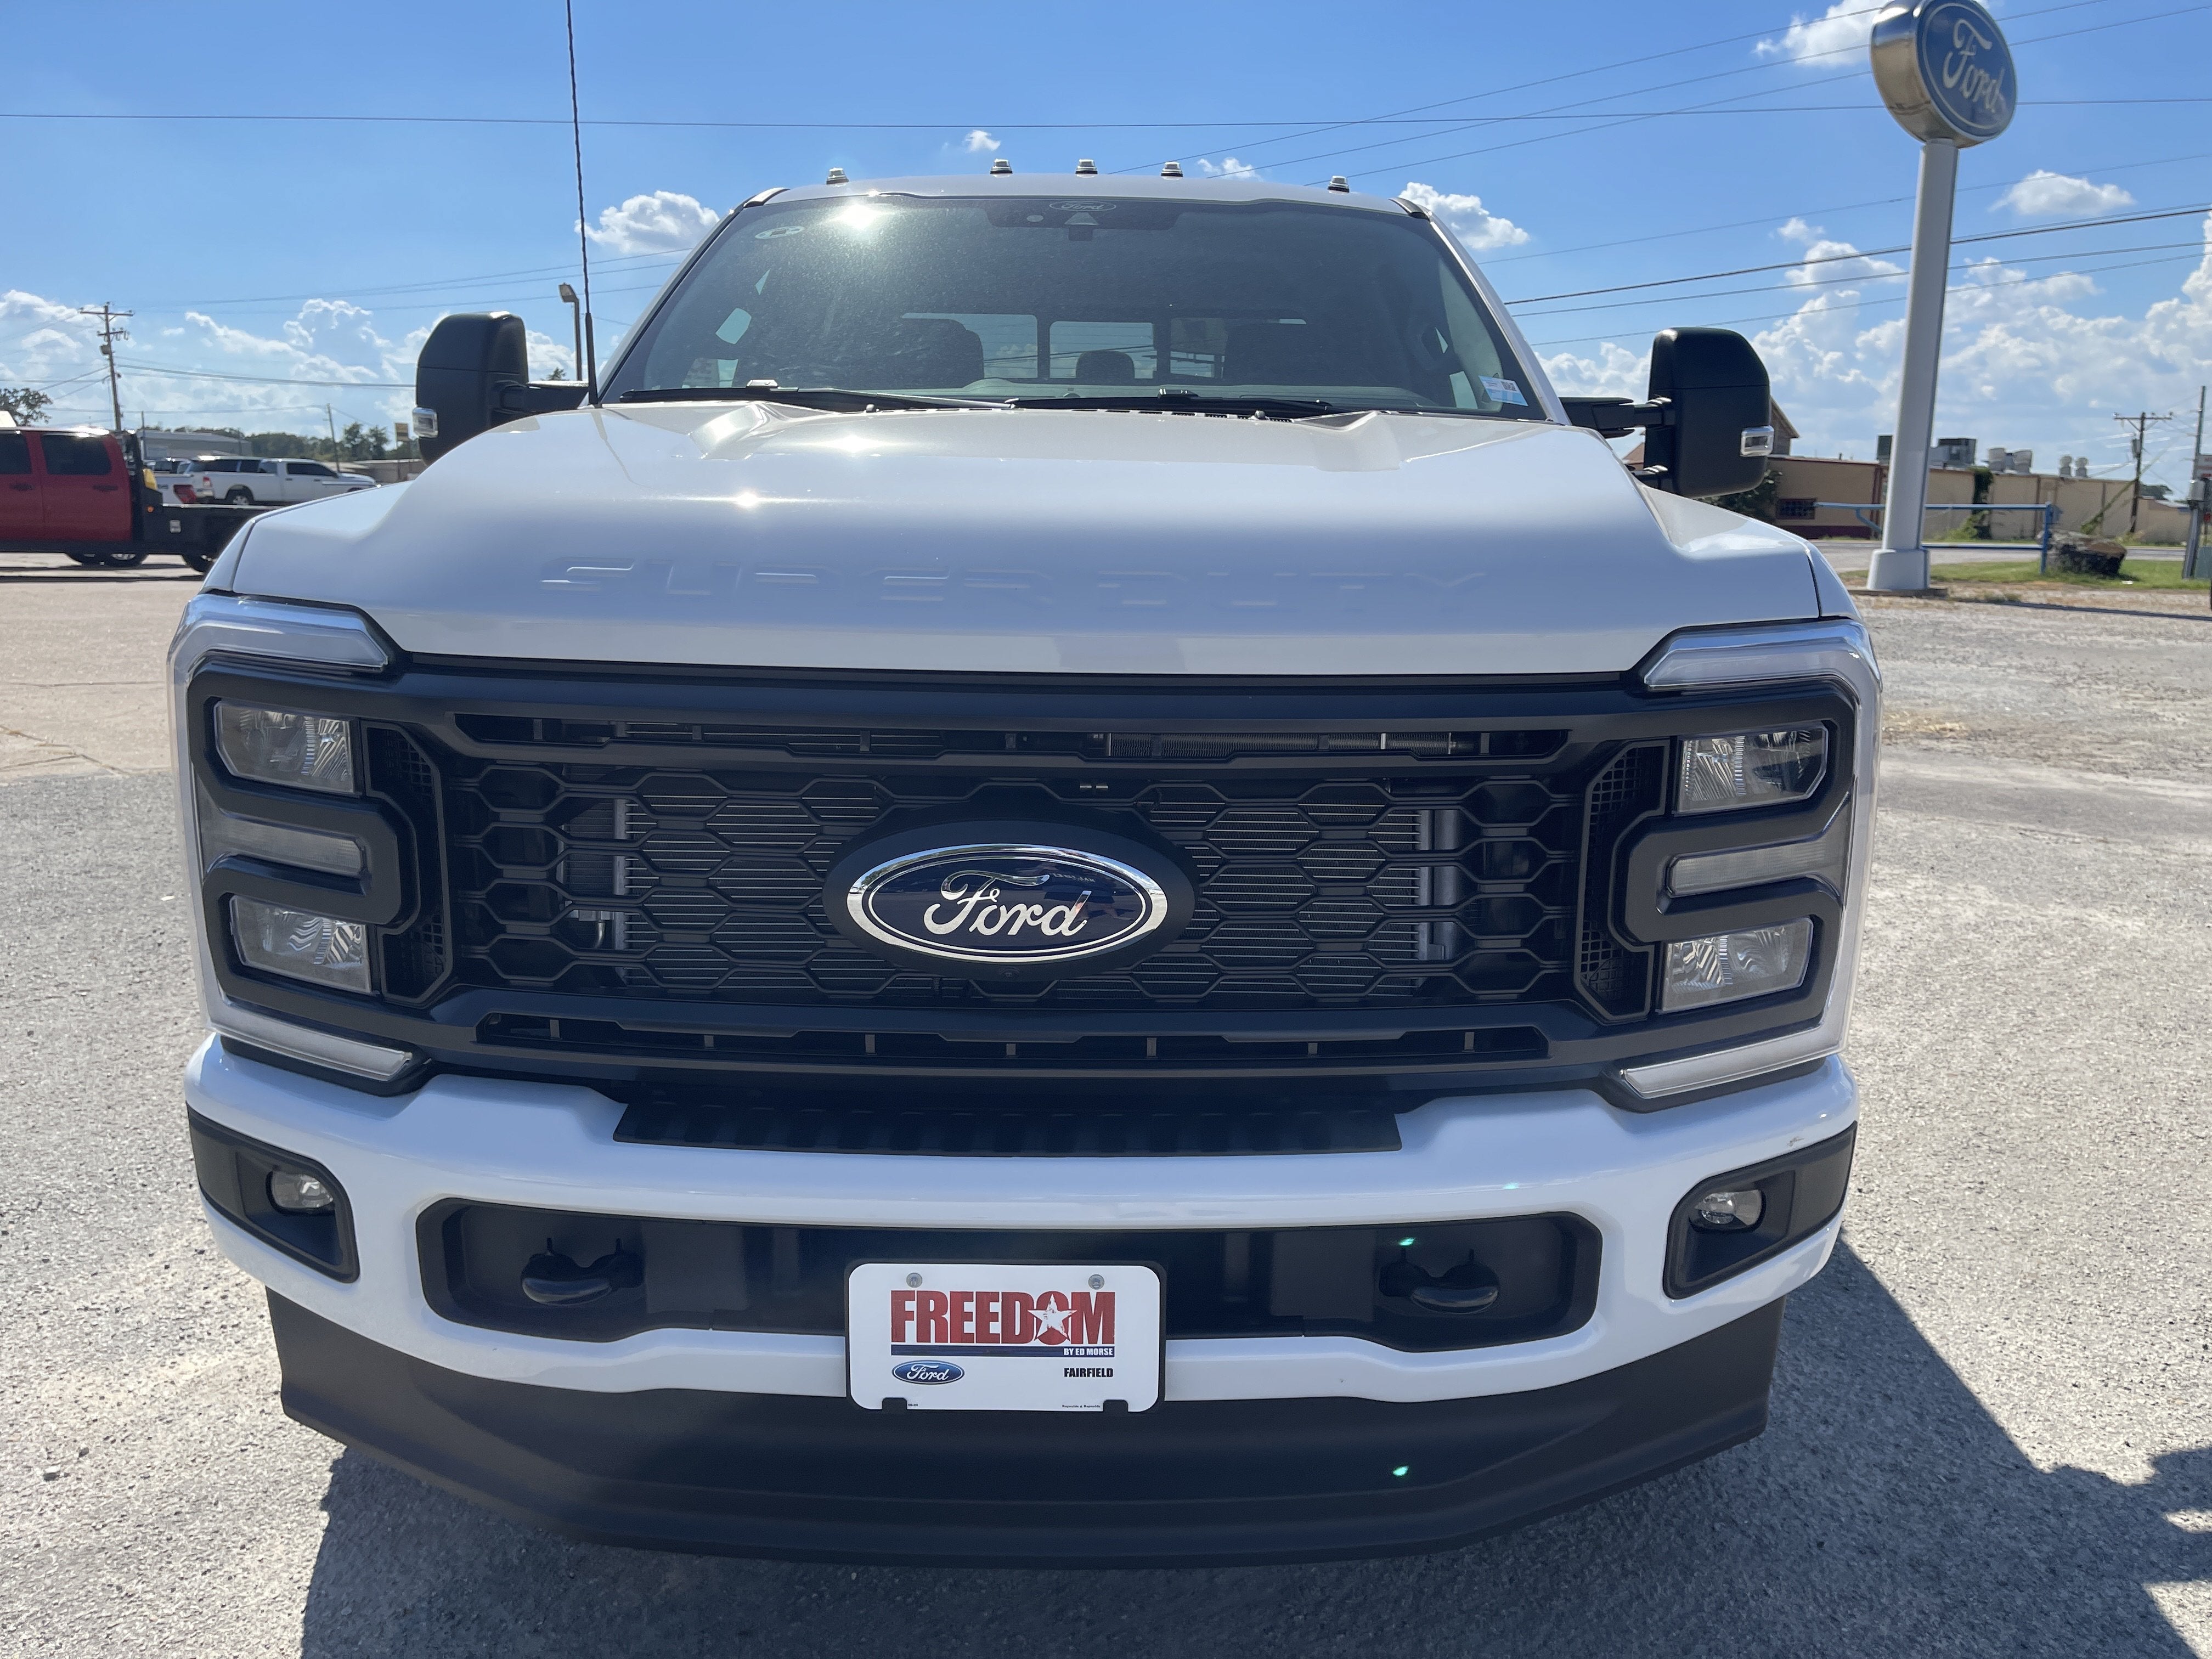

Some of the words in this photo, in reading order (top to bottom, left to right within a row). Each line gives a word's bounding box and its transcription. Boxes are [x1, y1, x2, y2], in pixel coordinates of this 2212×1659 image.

[1943, 19, 2006, 113] Ford
[1061, 201, 1105, 210] Ford
[924, 870, 1092, 936] Ford
[891, 1290, 1115, 1346] FREEDOM
[906, 1364, 949, 1382] Ford
[1064, 1368, 1114, 1378] FAIRFIELD
